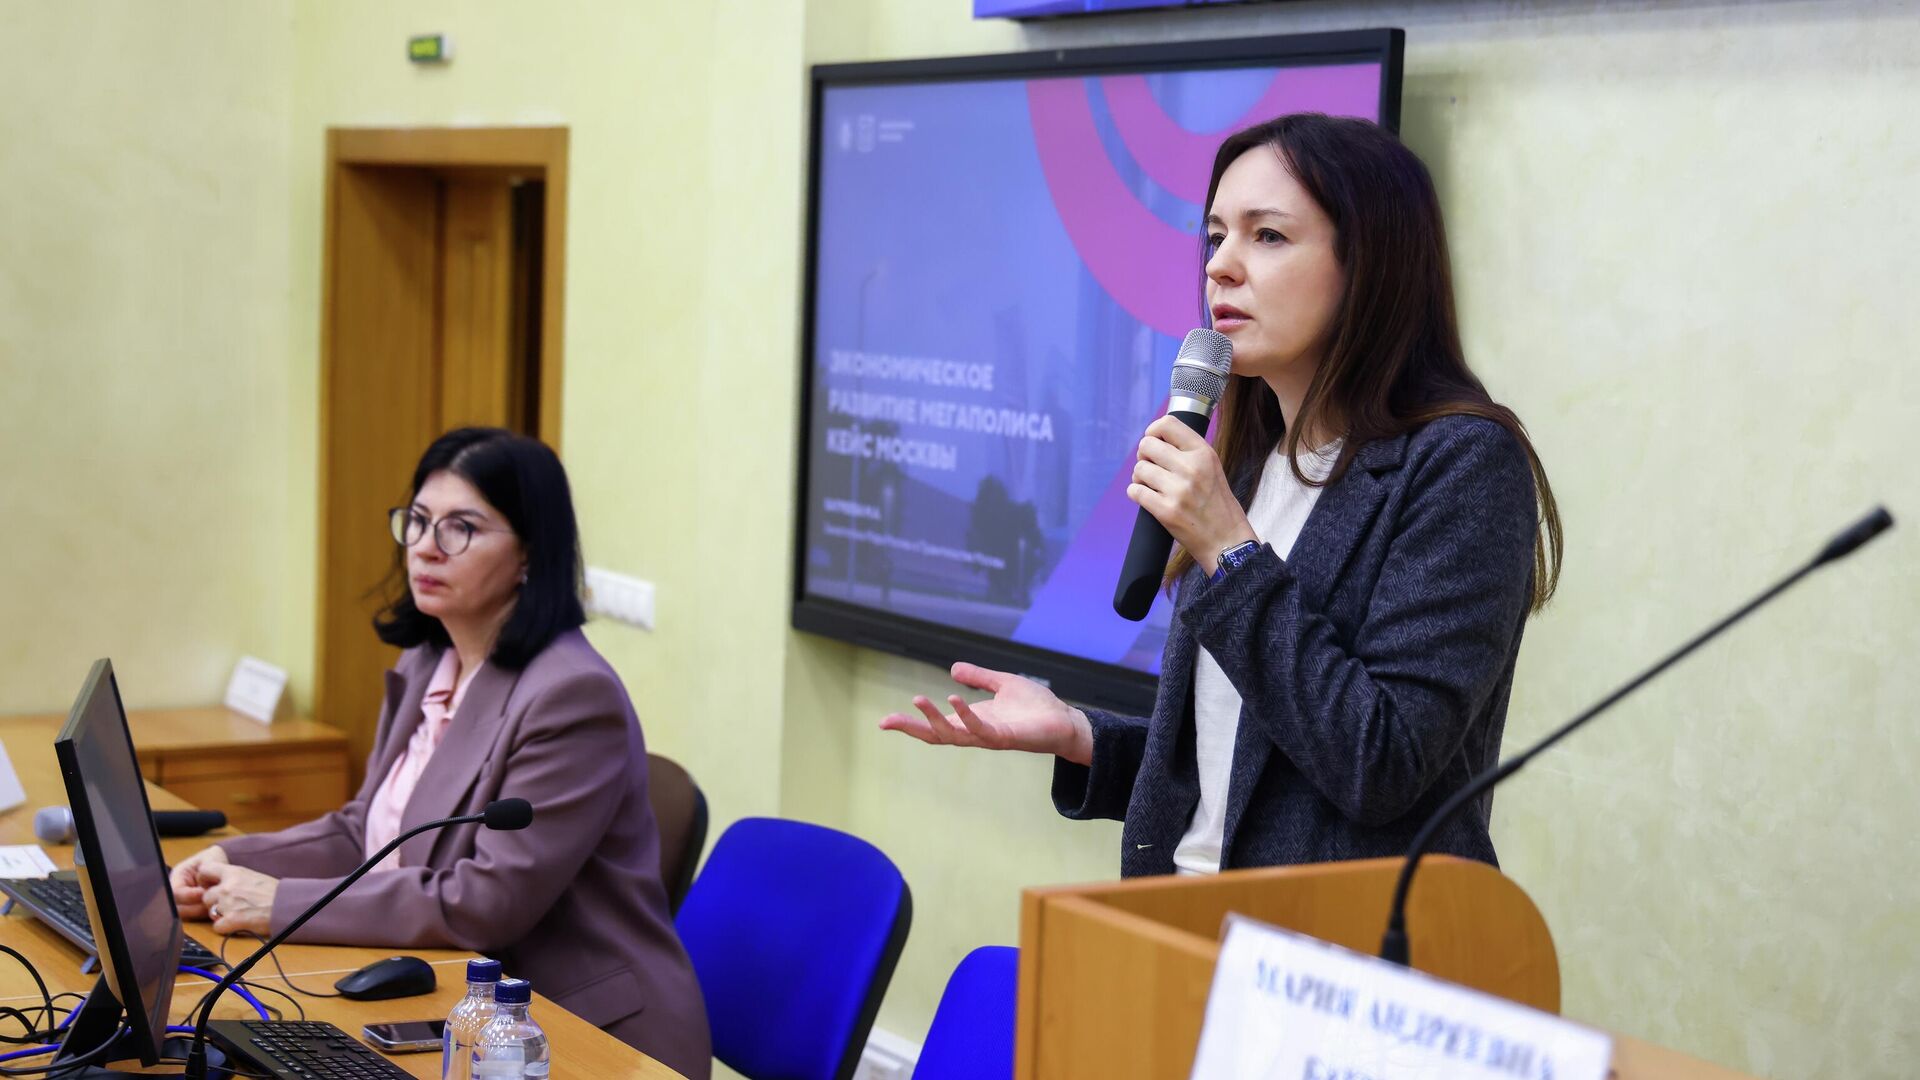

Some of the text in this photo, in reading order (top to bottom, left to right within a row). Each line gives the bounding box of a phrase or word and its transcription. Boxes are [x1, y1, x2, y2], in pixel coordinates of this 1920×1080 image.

[829, 350, 995, 391] ЭКОНОМИЧЕСКОЕ
[827, 388, 1055, 442] РАЗВИТИЕ МЕГАПОЛИСА
[826, 424, 957, 471] КЕЙС МОСКВЫ
